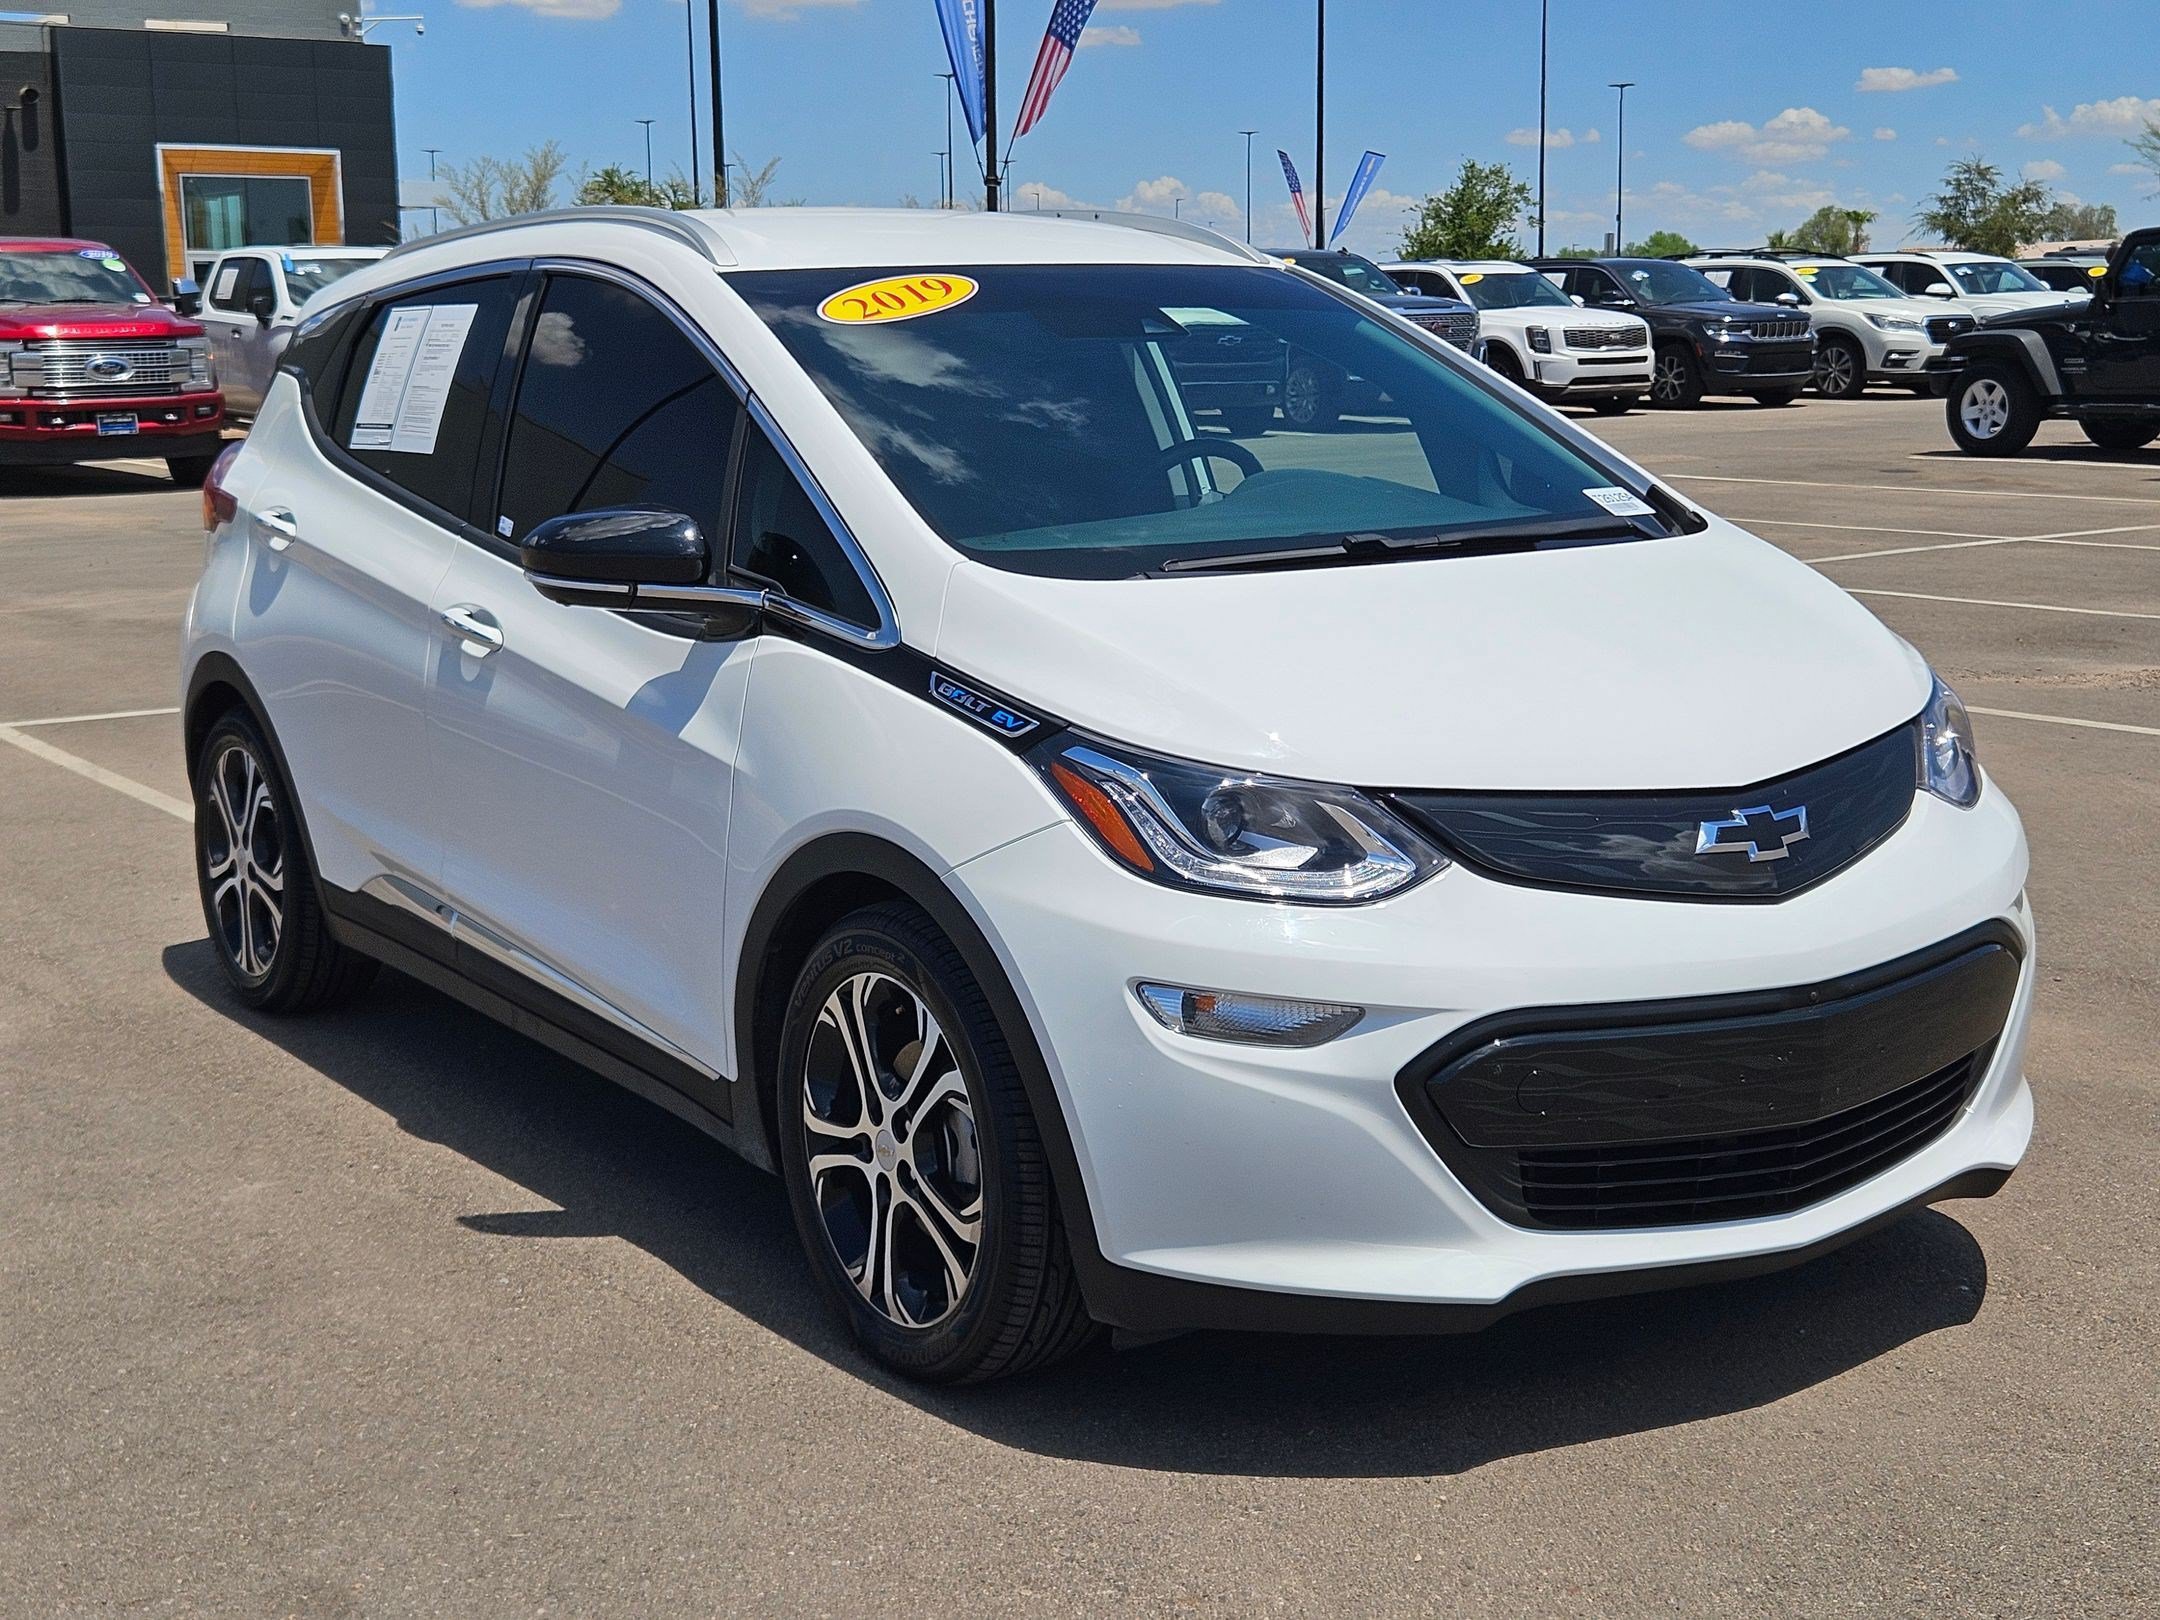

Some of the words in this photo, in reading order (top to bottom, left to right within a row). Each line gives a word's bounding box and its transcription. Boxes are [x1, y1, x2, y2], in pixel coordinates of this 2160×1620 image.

[842, 278, 953, 319] 2019
[938, 682, 992, 712] BOLT
[991, 710, 1024, 728] EV
[833, 938, 854, 958] V2
